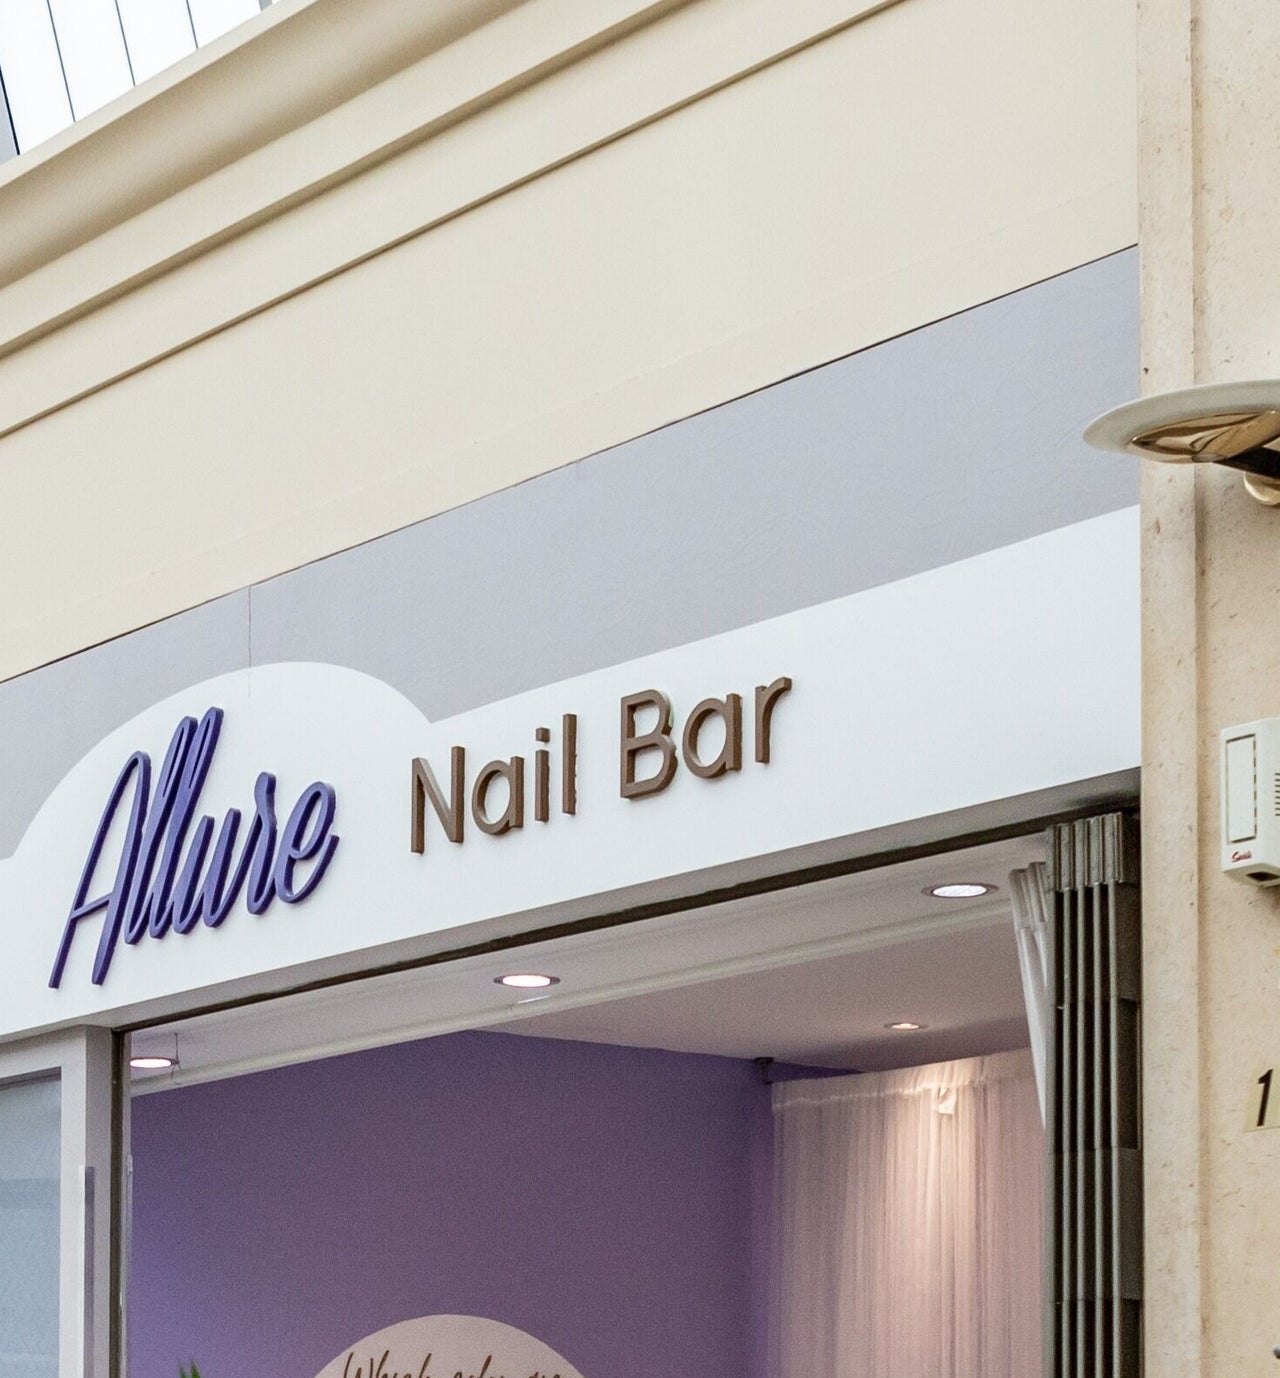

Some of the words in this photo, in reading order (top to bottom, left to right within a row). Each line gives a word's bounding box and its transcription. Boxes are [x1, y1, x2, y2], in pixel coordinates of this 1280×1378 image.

[48, 706, 340, 989] Allure
[410, 713, 578, 854] Nail
[620, 676, 792, 799] Bar
